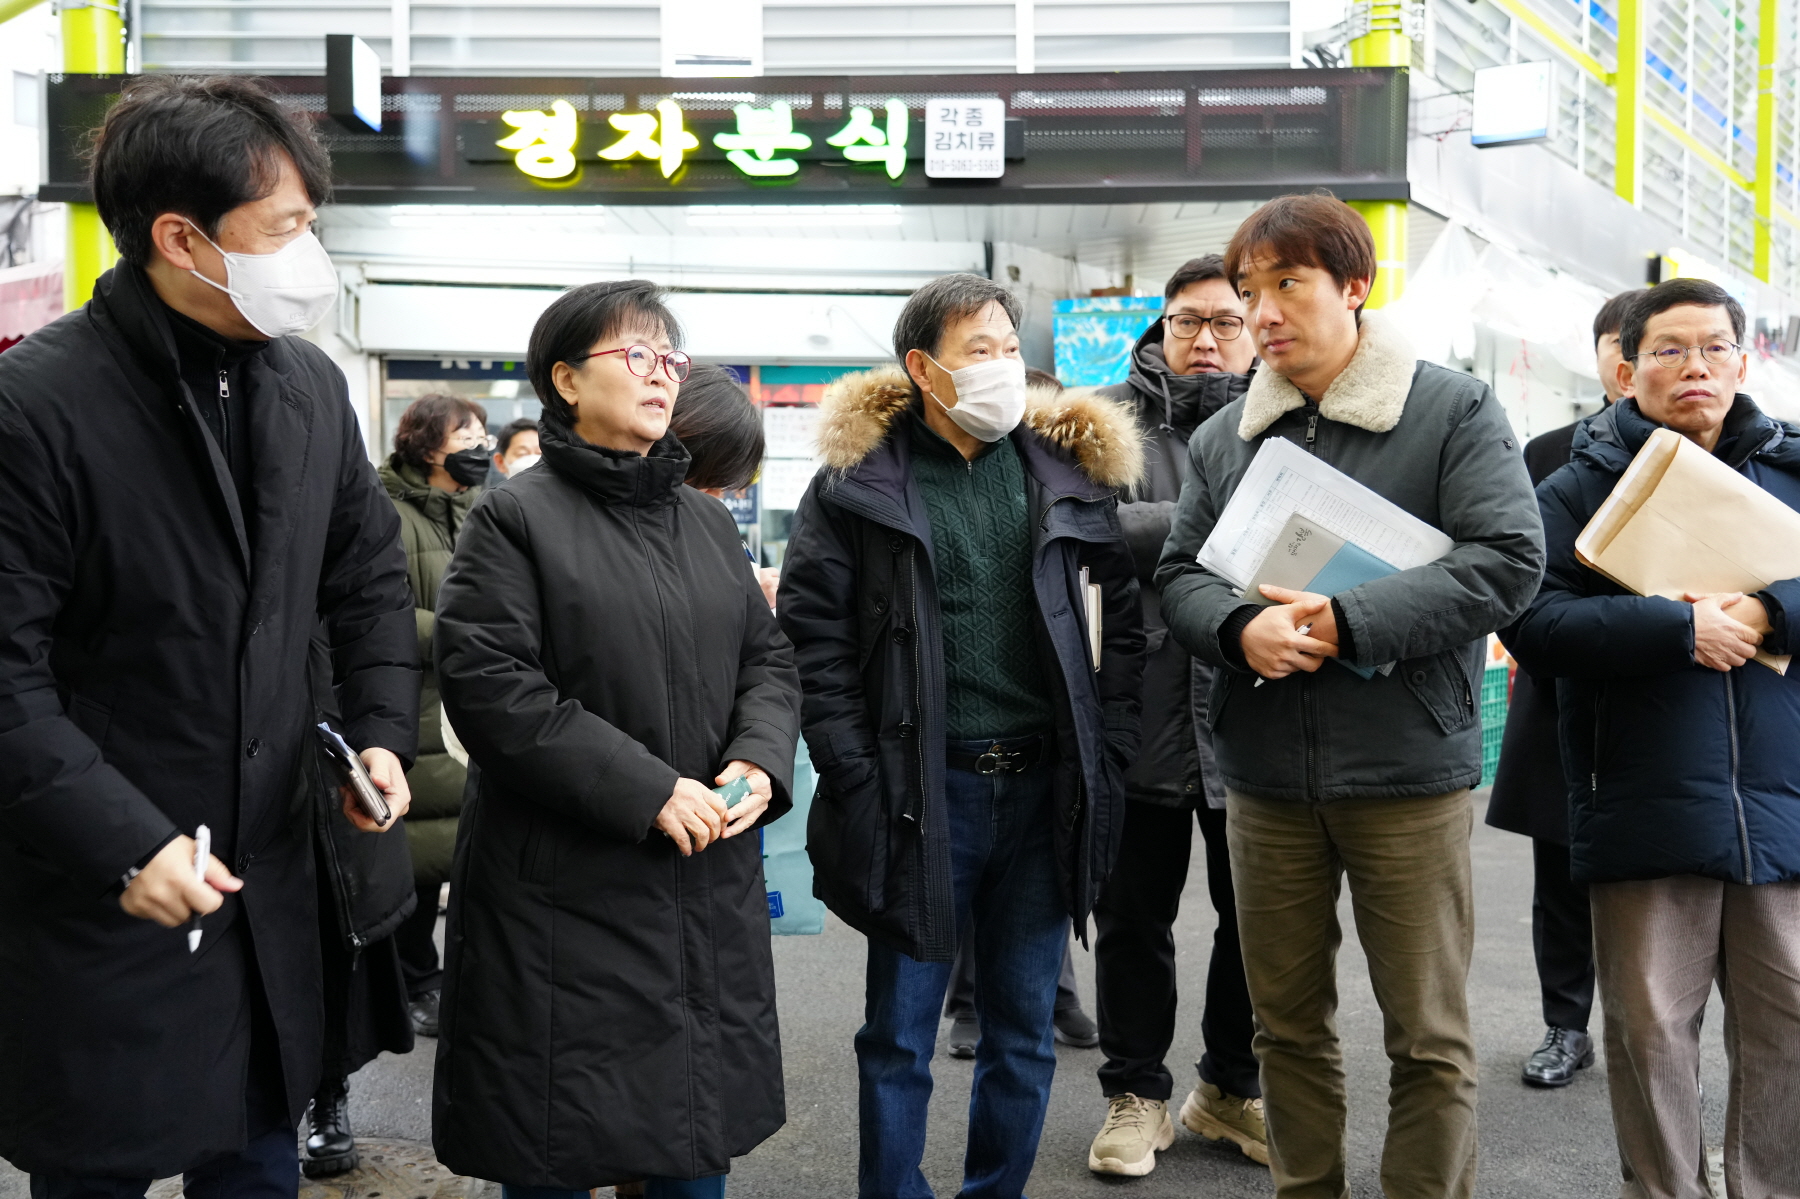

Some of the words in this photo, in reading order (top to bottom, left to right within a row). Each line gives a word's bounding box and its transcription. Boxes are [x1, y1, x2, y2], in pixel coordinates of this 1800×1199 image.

[940, 107, 983, 127] 각종
[495, 98, 909, 180] 경자분식
[934, 131, 995, 151] 김치류
